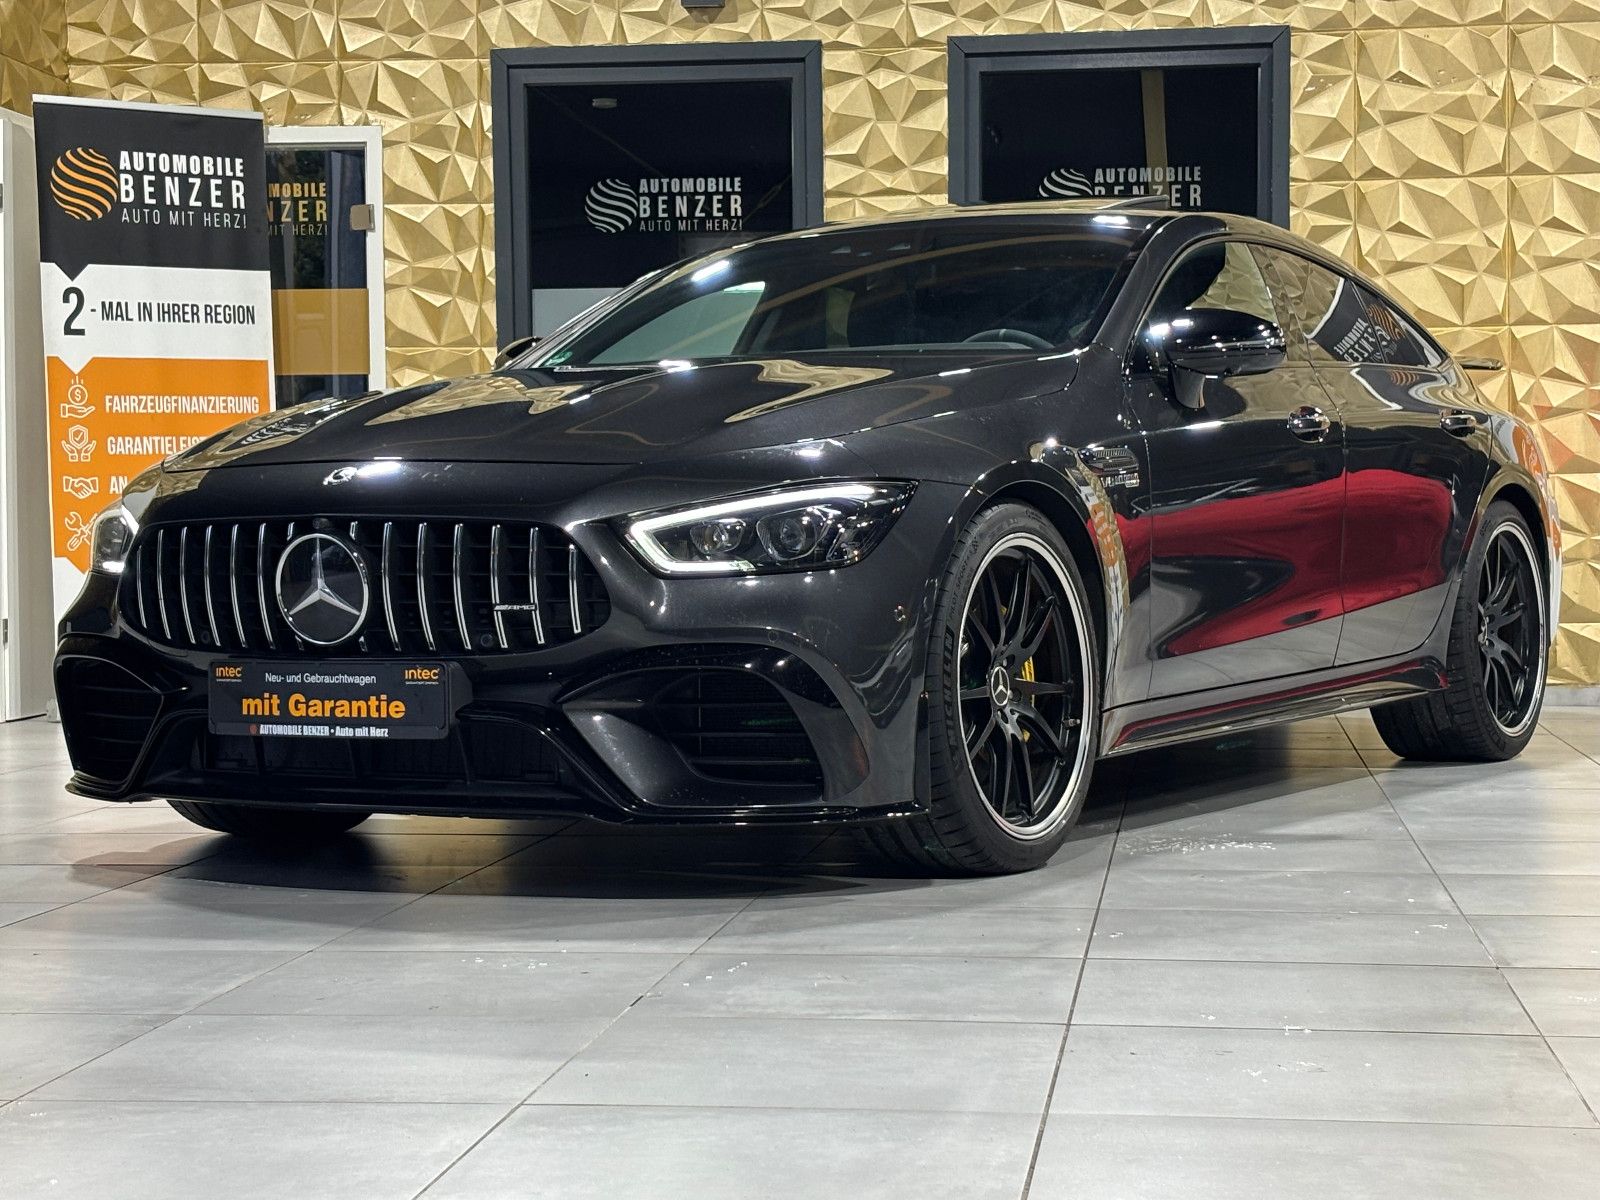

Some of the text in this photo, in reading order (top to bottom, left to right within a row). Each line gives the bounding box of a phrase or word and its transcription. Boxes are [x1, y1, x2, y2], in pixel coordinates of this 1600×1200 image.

[119, 150, 245, 178] AUTOMOBILE
[1094, 166, 1202, 184] AUTOMOBILE
[120, 174, 247, 210] BENZER
[268, 182, 327, 198] MOBILE
[639, 177, 742, 193] AUTOMOBILE
[266, 200, 328, 222] NZER
[639, 195, 742, 218] BENZER
[121, 208, 248, 229] AUTO MIT HERZ!
[639, 218, 744, 232] AUTO MIT HERZ!
[292, 223, 328, 236] HERZ!
[62, 286, 86, 336] 2
[101, 301, 134, 323] MAL
[137, 302, 153, 323] IN
[156, 302, 200, 324] IHRER
[204, 303, 256, 326] REGION
[105, 395, 260, 414] FAHRZEUGFINANZIERUNG
[265, 672, 377, 686] Neu- und Gebrauchtwagen
[241, 692, 406, 719] mit Garantie
[259, 724, 389, 738] AUTOMOBILE BENZER Auto mit Herz
